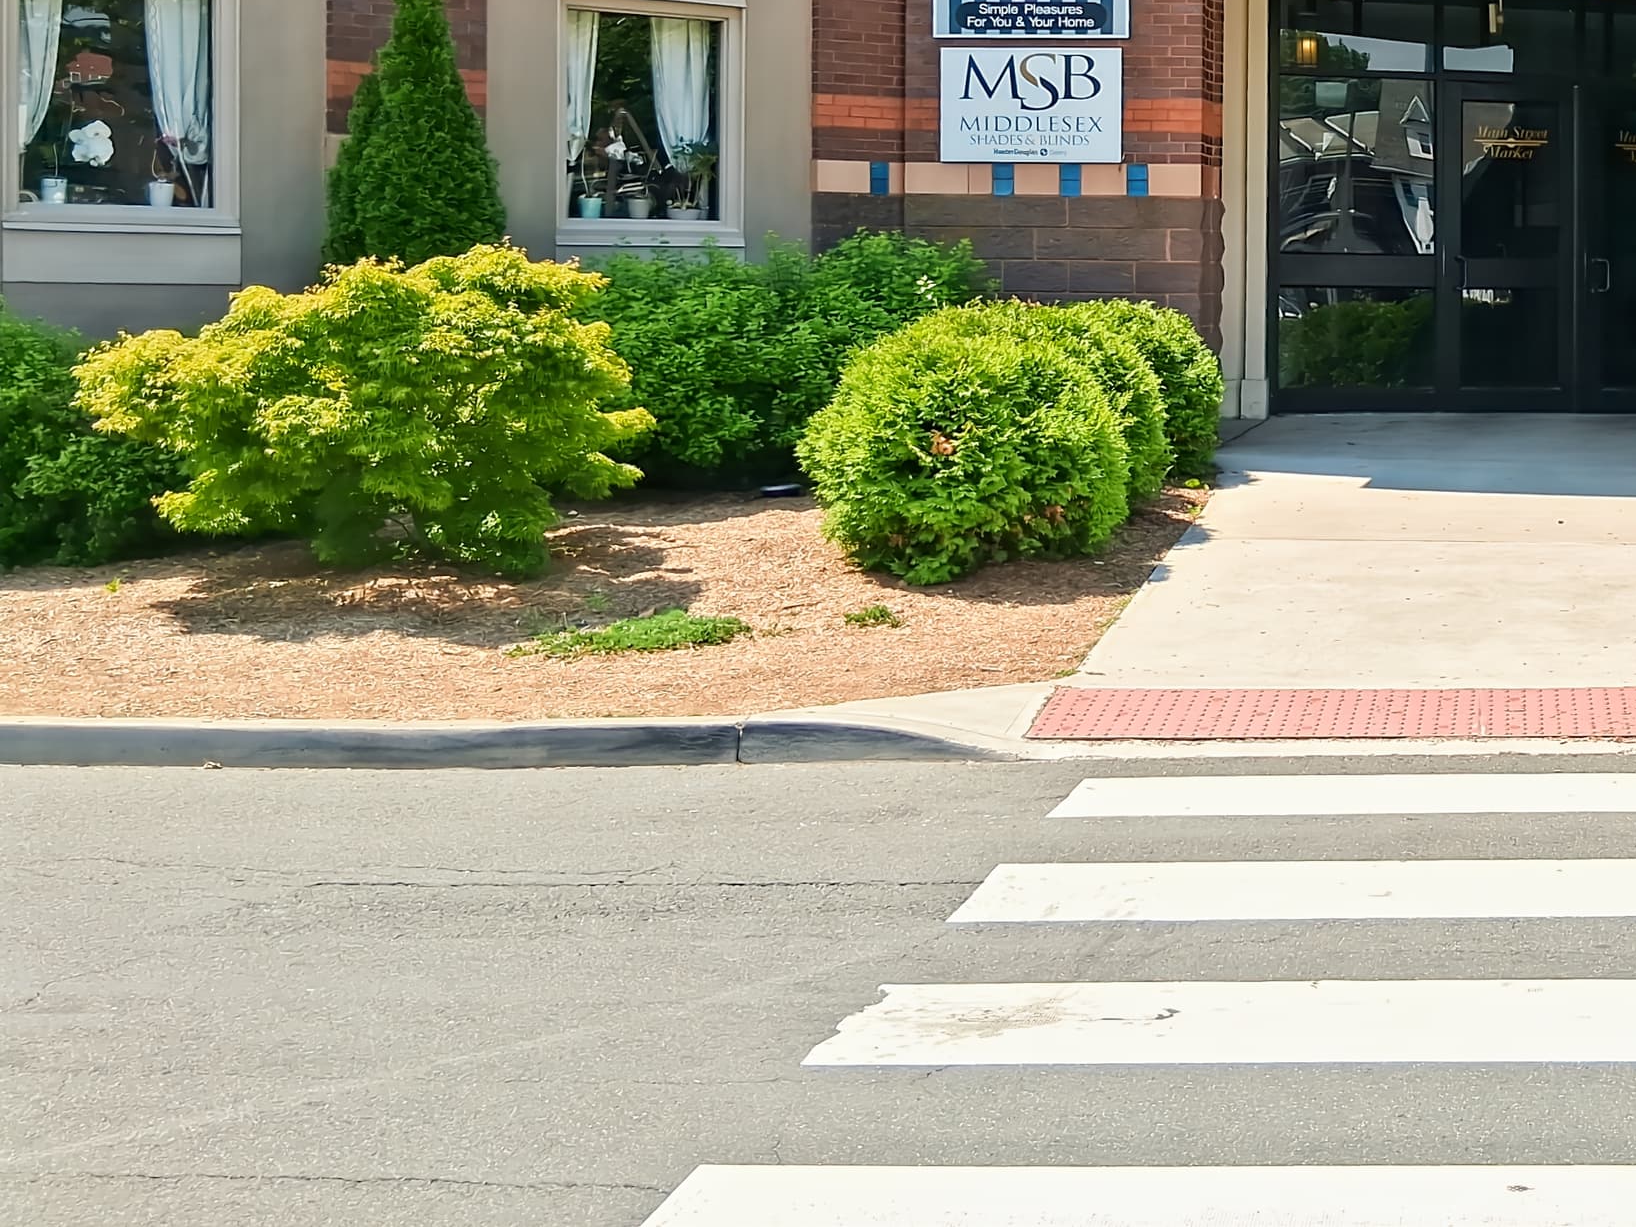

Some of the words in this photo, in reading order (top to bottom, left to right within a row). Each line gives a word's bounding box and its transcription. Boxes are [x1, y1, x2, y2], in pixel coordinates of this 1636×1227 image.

[978, 4, 1019, 16] Simple
[1024, 4, 1084, 15] Pleasures
[966, 17, 987, 28] For
[990, 17, 1012, 28] You
[1015, 17, 1026, 28] &
[1028, 17, 1056, 28] Your
[1058, 17, 1095, 28] Home
[958, 53, 1102, 111] MSB
[959, 115, 1103, 133] MIDDLESEX
[969, 135, 1024, 146] SHADES
[1039, 135, 1090, 146] BLINDS
